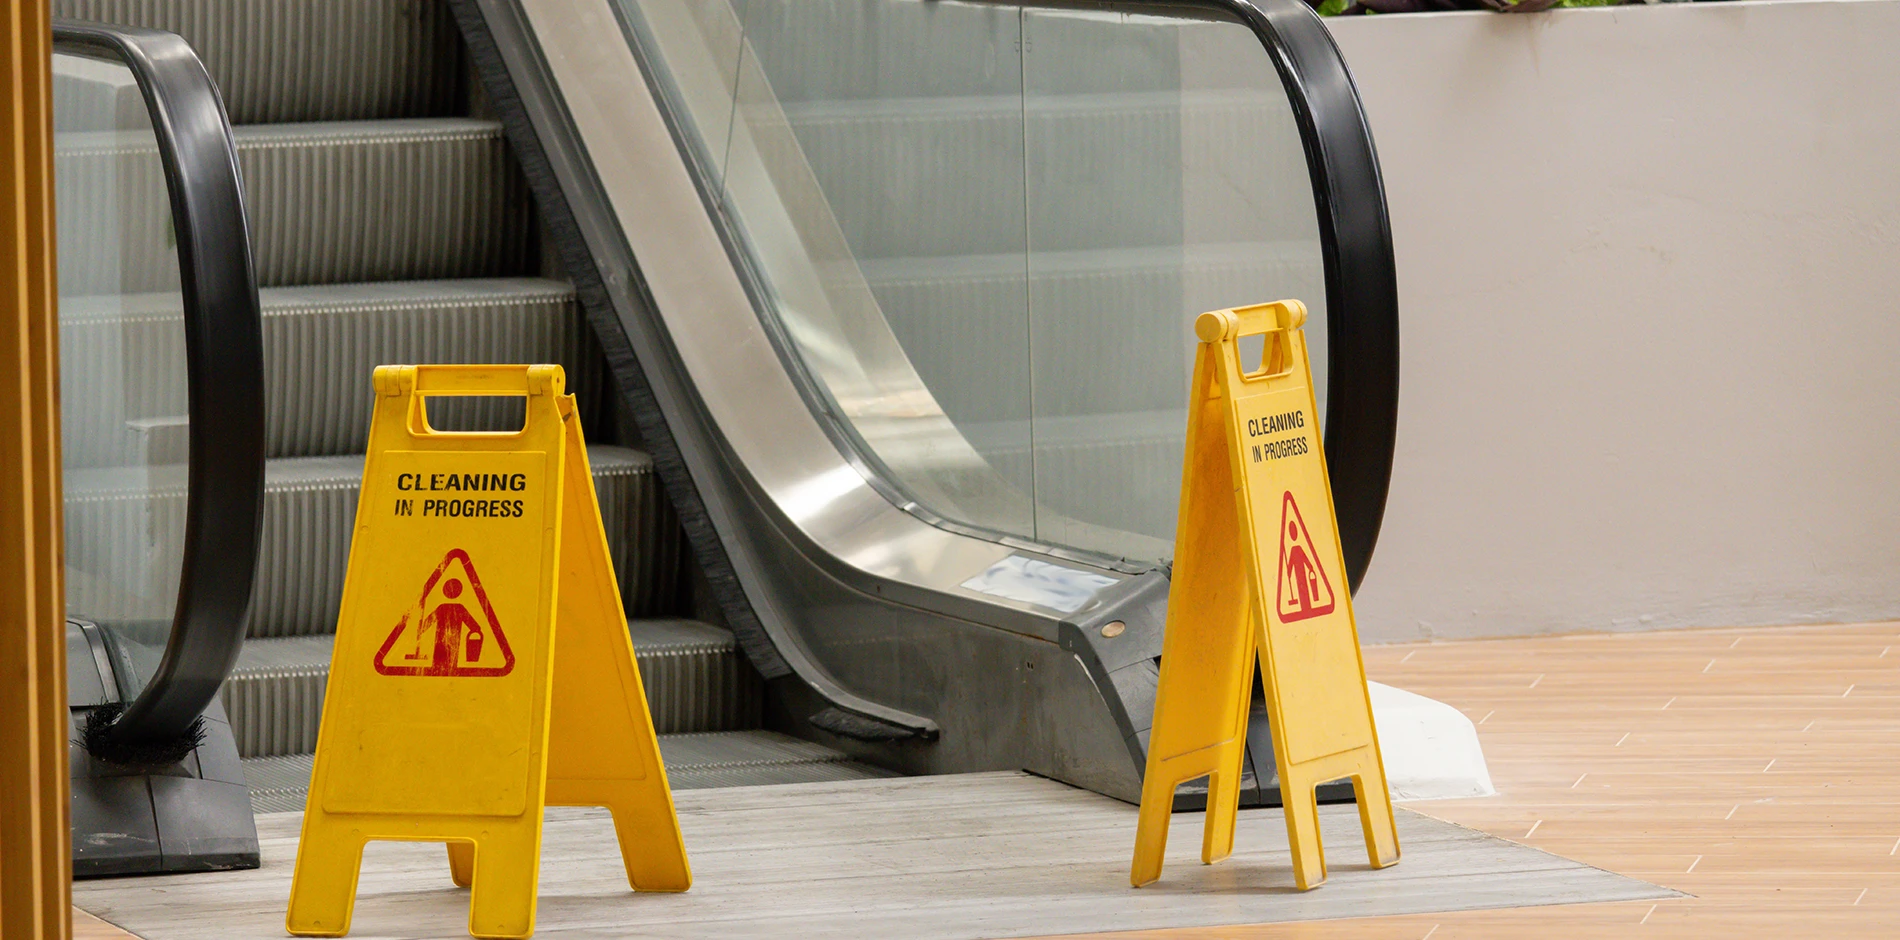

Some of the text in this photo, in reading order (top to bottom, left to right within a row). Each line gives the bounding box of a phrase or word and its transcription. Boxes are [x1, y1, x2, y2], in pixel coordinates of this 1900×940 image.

[1248, 410, 1304, 437] CLEANING
[1252, 436, 1308, 463] IN PROGRESS
[397, 473, 526, 491] CLEANING
[394, 499, 524, 517] IN PROGRESS
